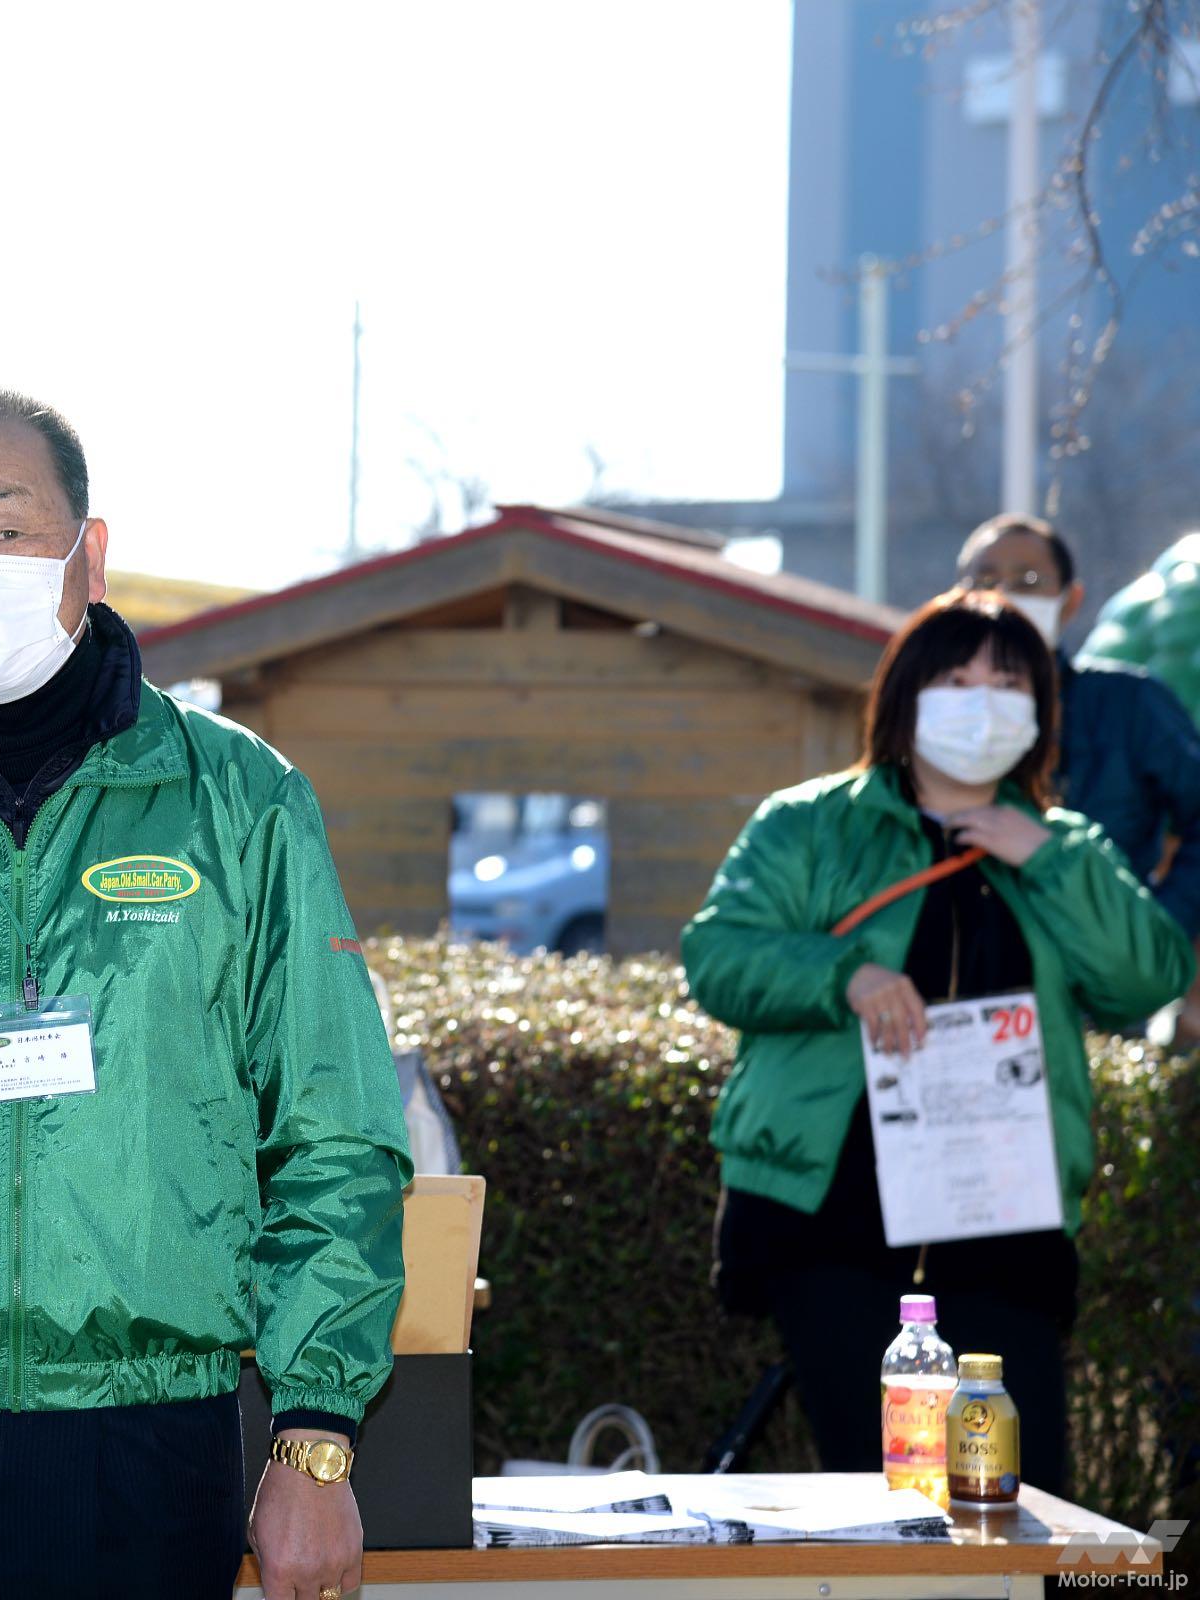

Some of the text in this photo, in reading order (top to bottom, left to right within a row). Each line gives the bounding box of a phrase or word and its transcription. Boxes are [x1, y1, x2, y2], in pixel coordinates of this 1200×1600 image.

[105, 909, 180, 924] M.Yoshizaki
[991, 1006, 1035, 1044] 20
[959, 1441, 998, 1455] BOSS
